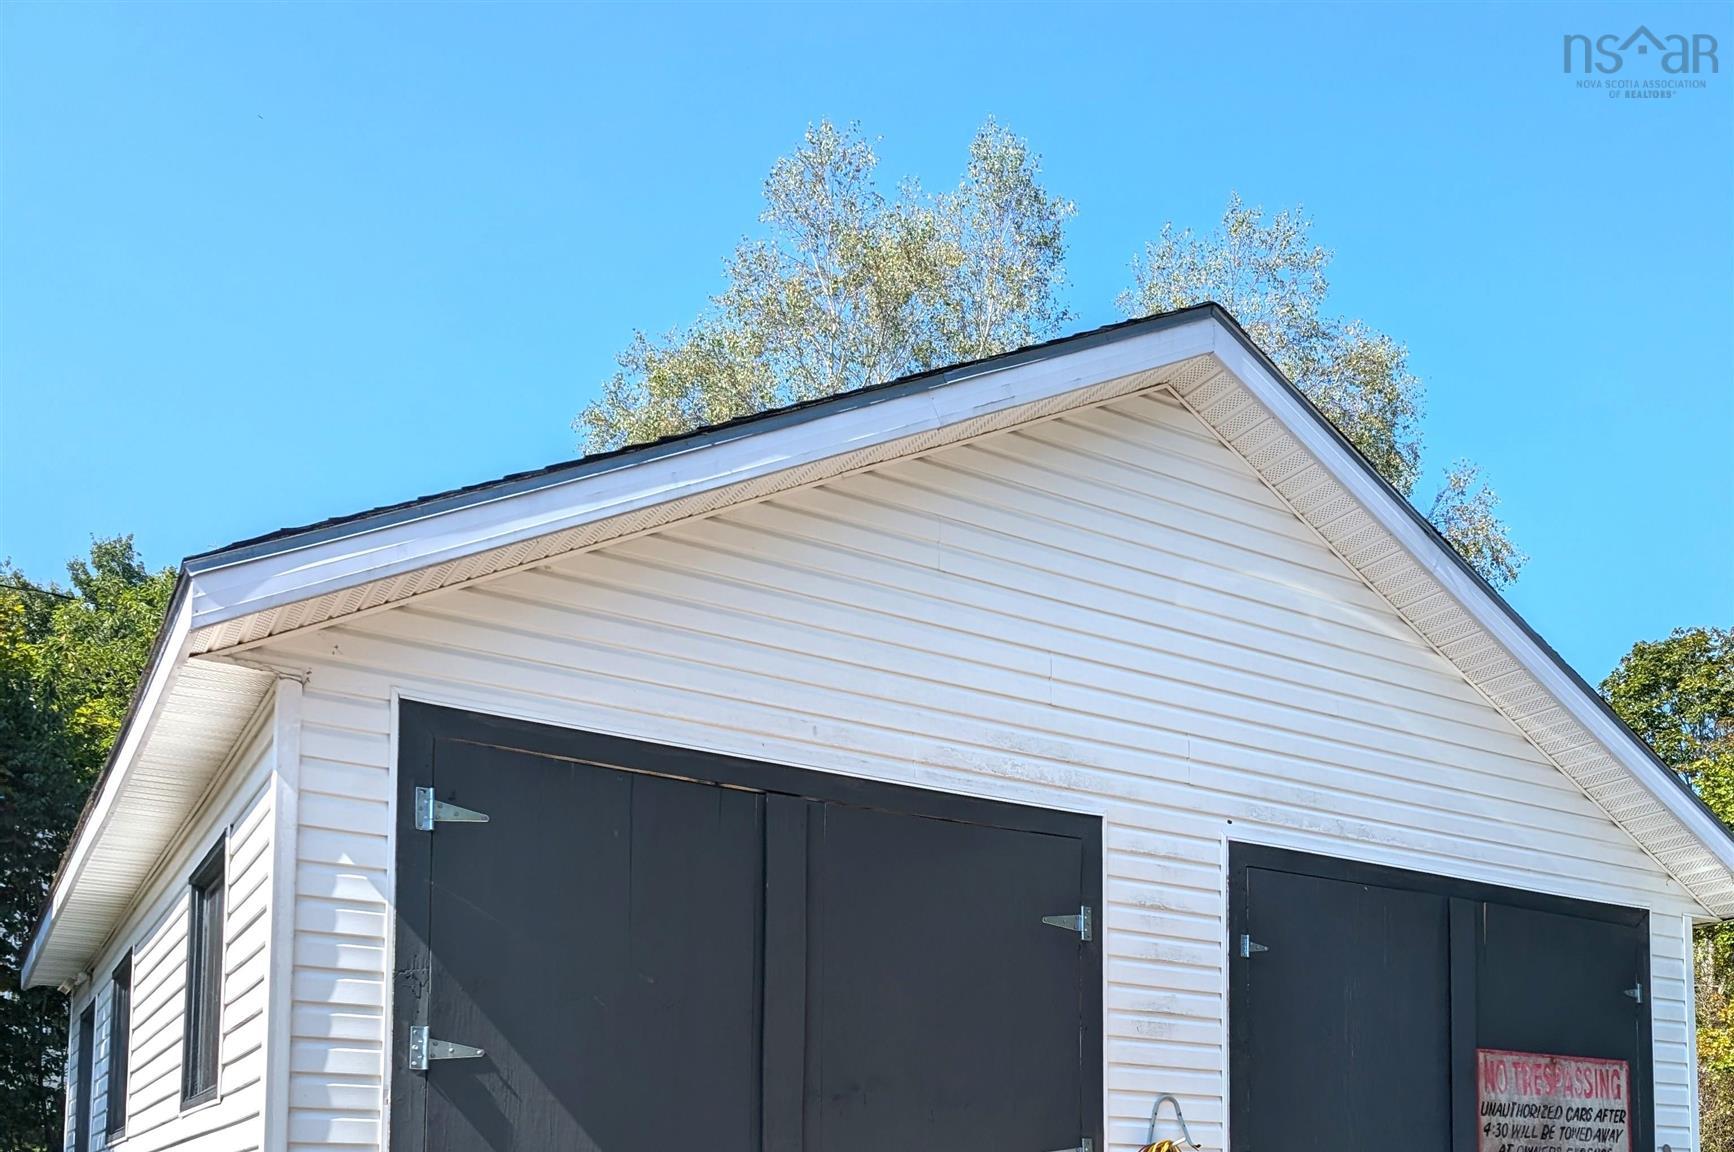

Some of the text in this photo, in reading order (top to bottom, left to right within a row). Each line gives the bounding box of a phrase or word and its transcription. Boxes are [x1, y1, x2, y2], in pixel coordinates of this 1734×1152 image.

[1484, 1058, 1622, 1100] NO TRESPASSING
[1480, 1101, 1627, 1124] UNAUTHORIZED CARS AFTER
[1483, 1122, 1509, 1140] 4:30
[1510, 1123, 1538, 1139] WILL
[1540, 1124, 1556, 1140] BE
[1592, 1128, 1624, 1144] AWAY
